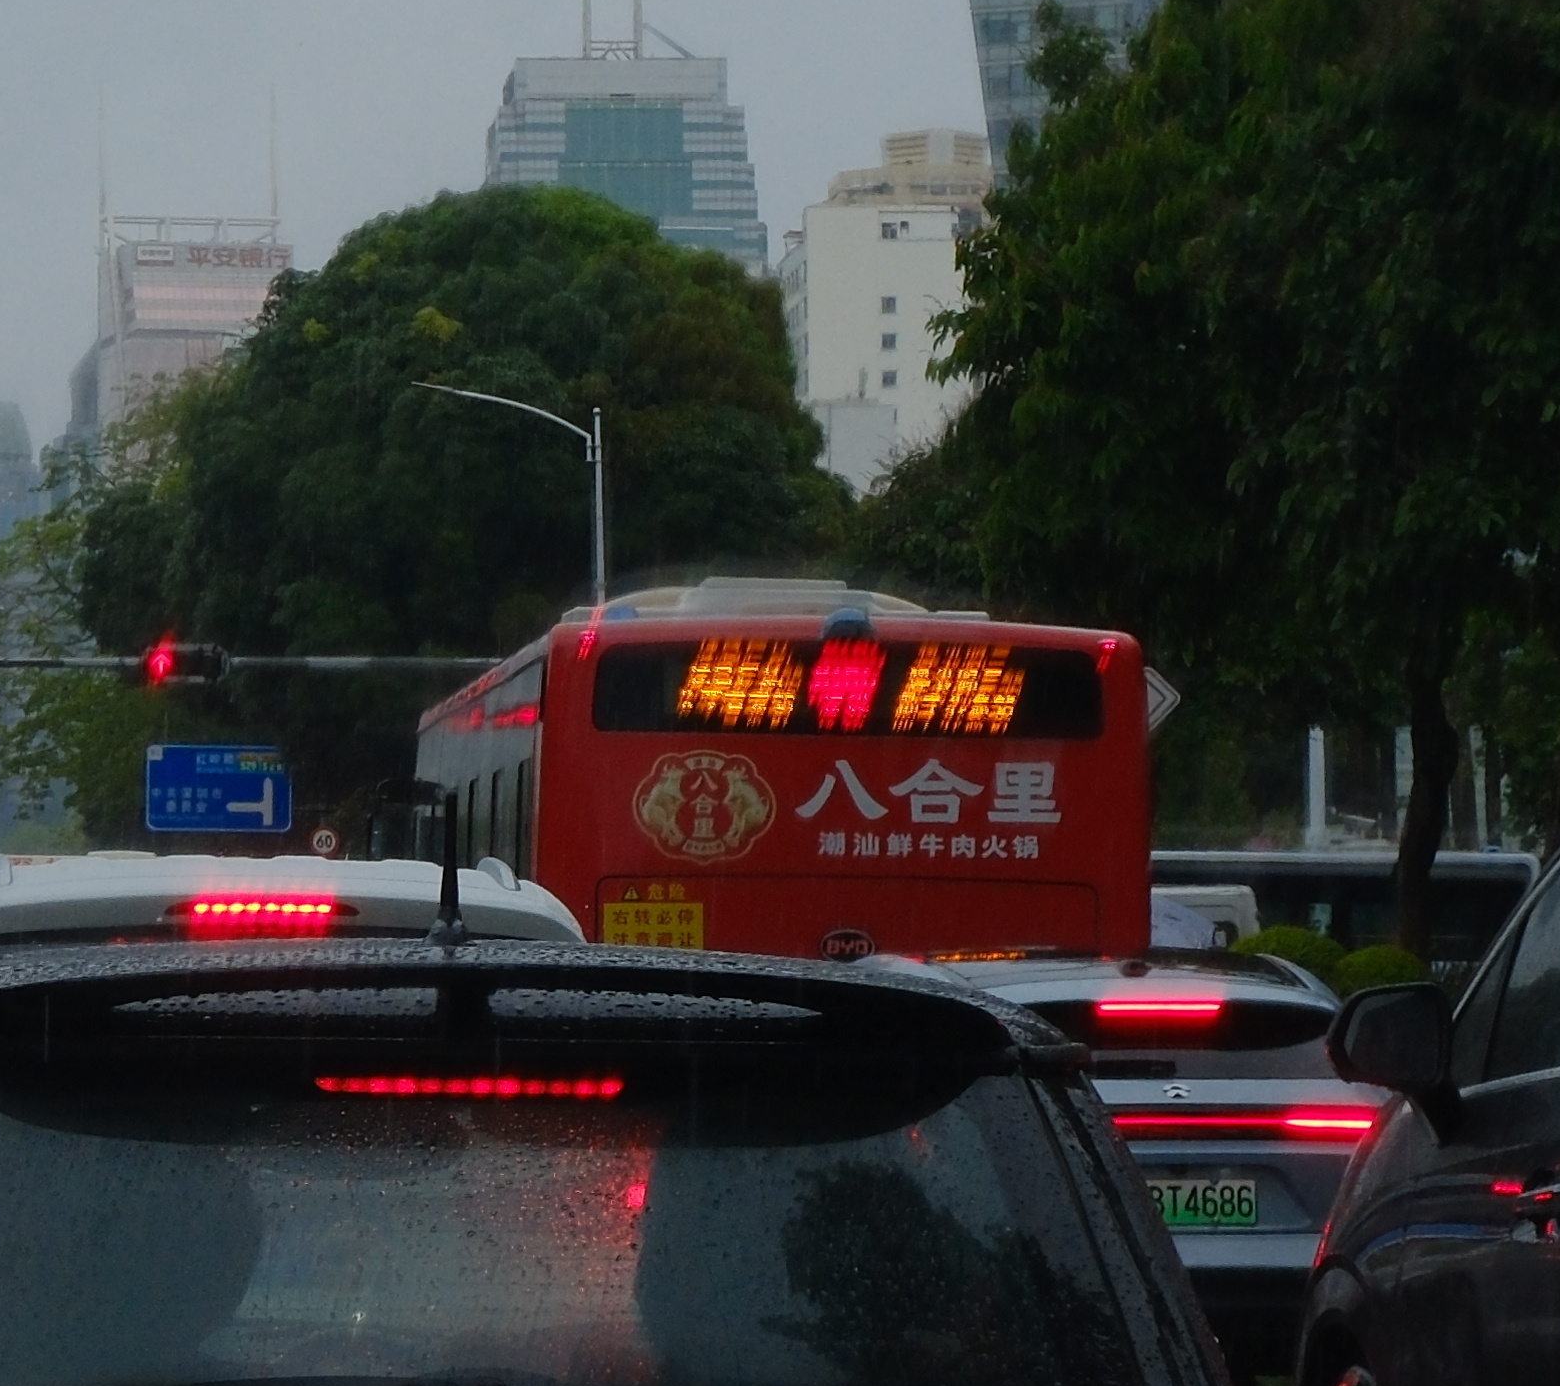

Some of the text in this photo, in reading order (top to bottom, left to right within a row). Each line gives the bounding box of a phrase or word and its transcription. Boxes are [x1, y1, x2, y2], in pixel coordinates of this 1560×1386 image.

[187, 246, 292, 268] 平安银行
[794, 758, 1062, 824] 八合里
[689, 770, 719, 838] 八合里
[316, 835, 333, 849] 60
[817, 831, 1040, 860] 潮汕鲜牛肉火锅
[648, 883, 686, 900] 危险
[612, 908, 695, 926] 右转必停
[826, 938, 869, 954] BYD
